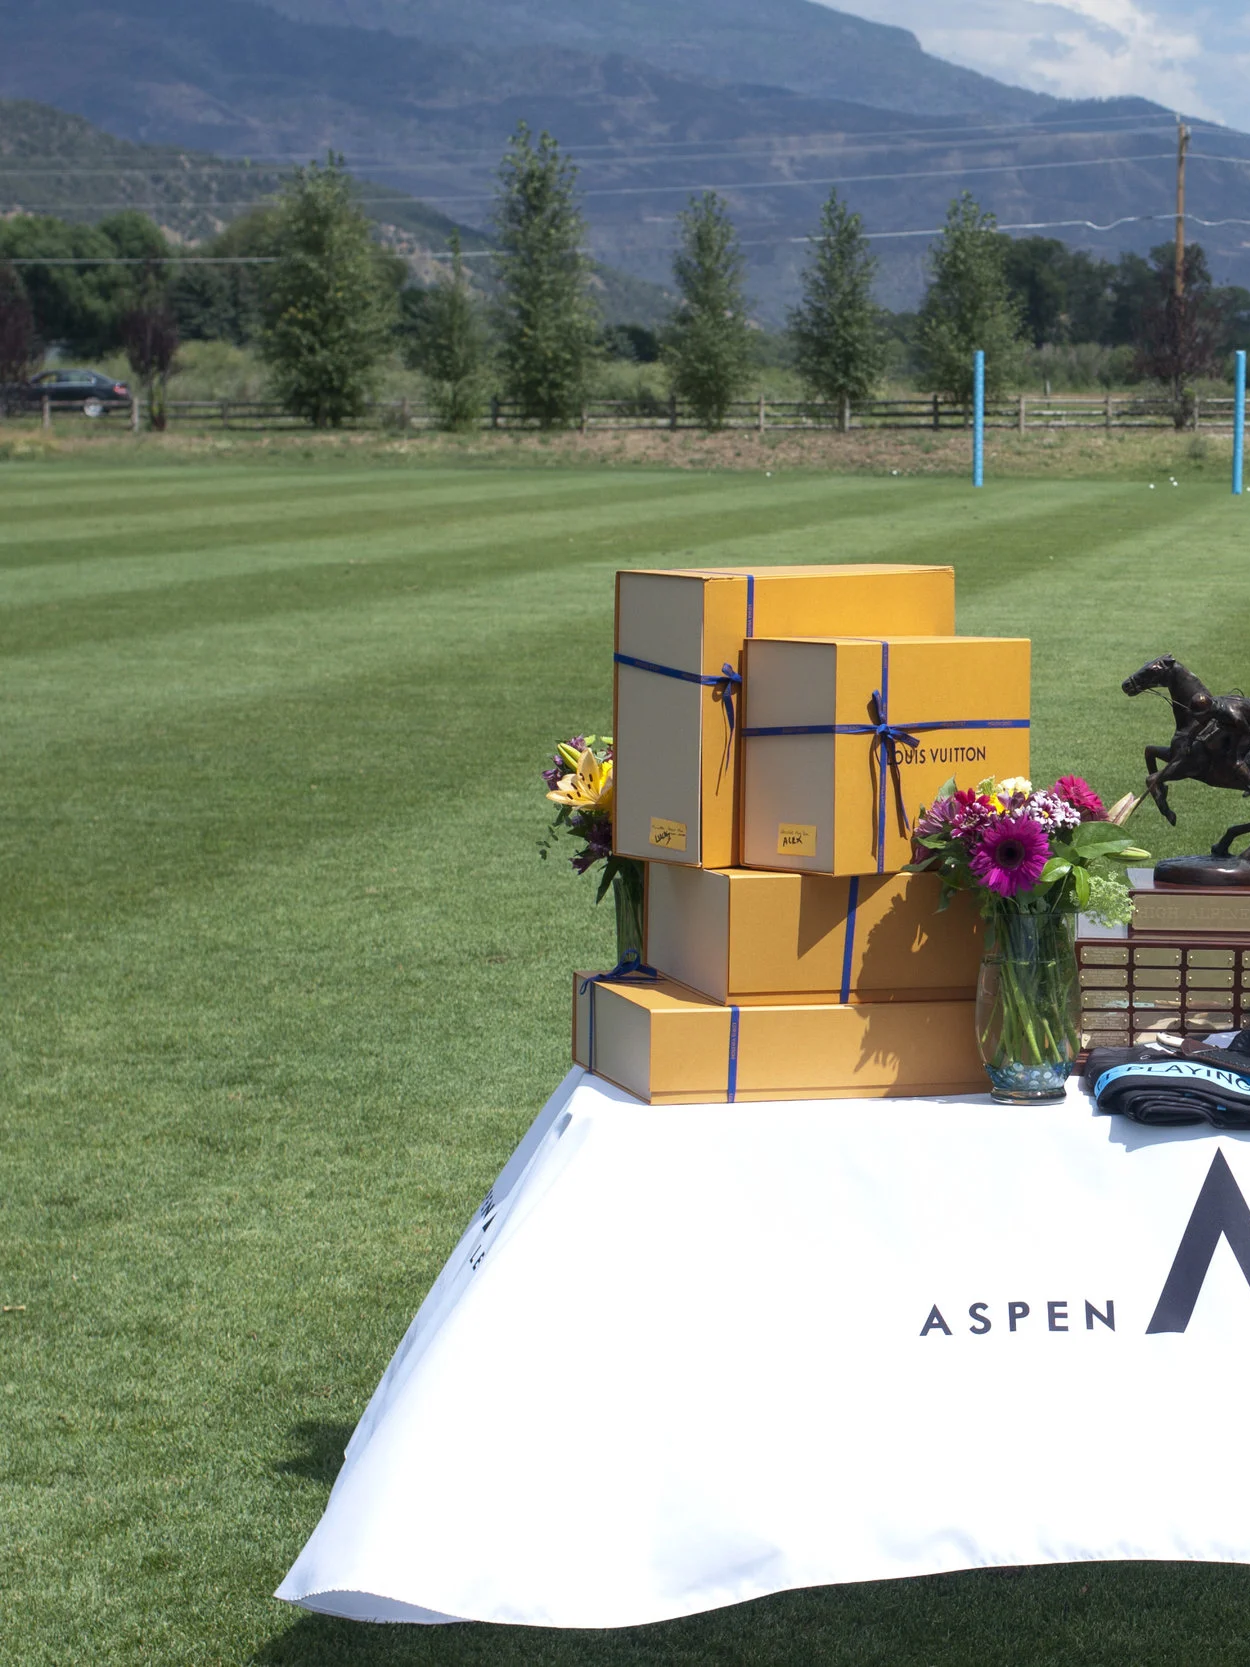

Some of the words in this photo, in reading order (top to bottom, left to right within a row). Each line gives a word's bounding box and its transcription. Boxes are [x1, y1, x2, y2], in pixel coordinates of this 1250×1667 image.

[930, 746, 986, 763] VUITTON
[1138, 906, 1180, 920] HIGH
[1188, 907, 1250, 920] ALPINE
[920, 1300, 1115, 1336] ASPEN
